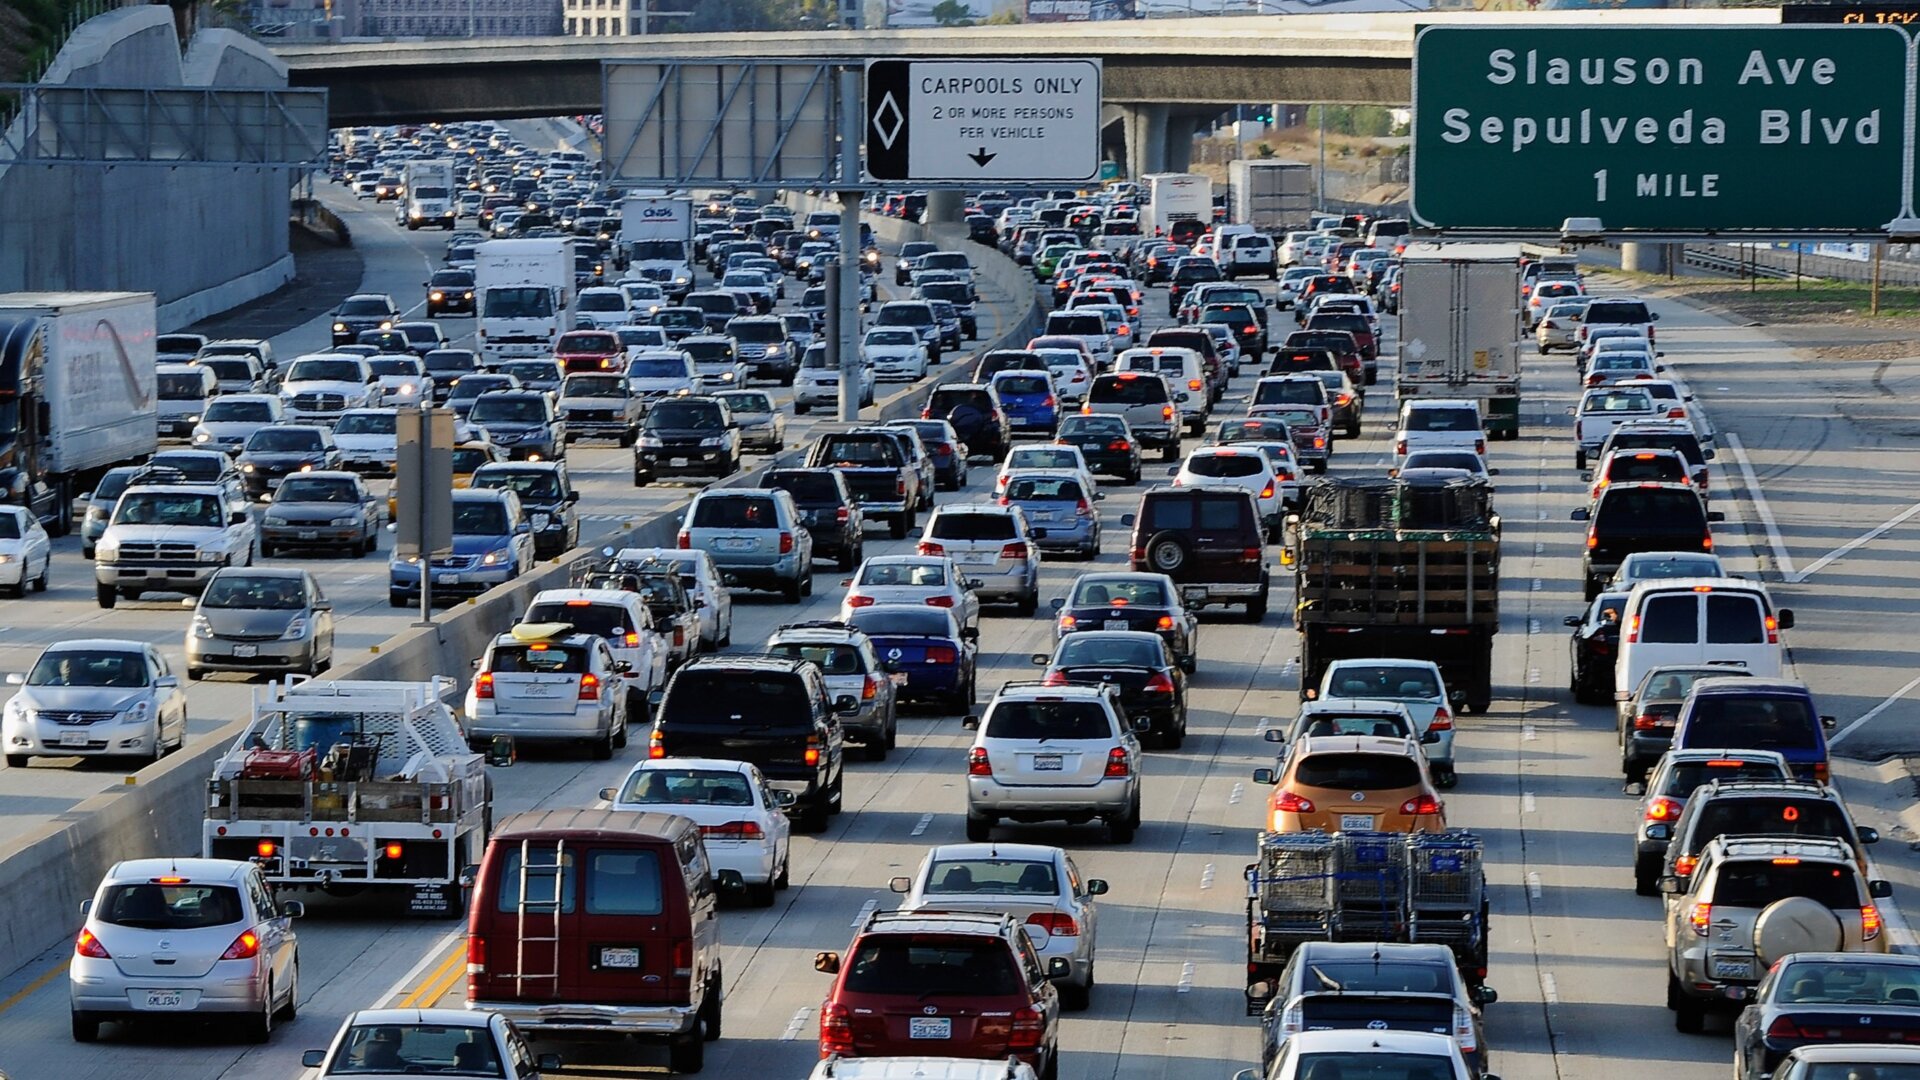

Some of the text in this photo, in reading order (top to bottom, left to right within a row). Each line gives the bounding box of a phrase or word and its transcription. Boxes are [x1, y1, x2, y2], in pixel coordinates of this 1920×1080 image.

[1487, 49, 1835, 84] Slauson Ave
[922, 78, 1082, 95] CARPOOLS ONLY
[932, 106, 1073, 120] 2 OR MORE PERSONS
[960, 127, 1045, 139] PER VEHICLE
[1442, 109, 1879, 152] Sepulveda Blvd
[1595, 170, 1719, 201] 1 MILE
